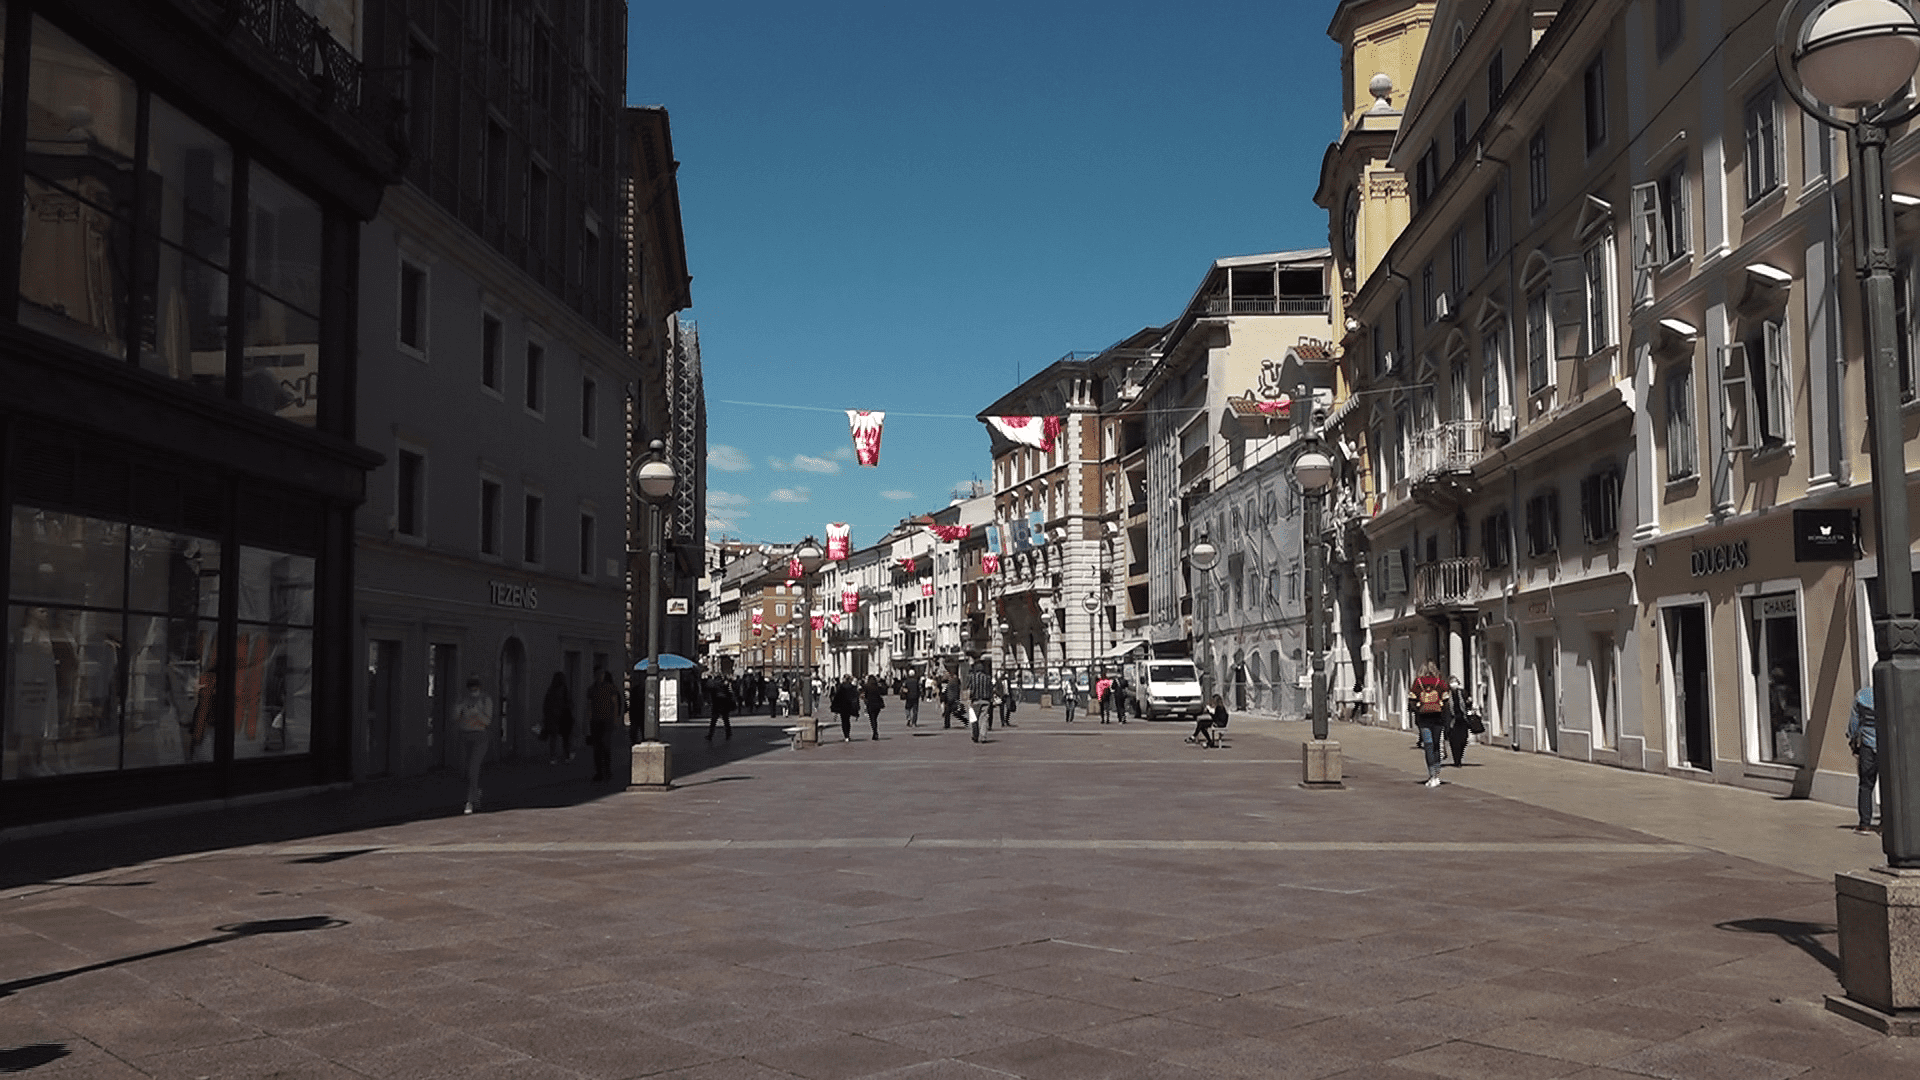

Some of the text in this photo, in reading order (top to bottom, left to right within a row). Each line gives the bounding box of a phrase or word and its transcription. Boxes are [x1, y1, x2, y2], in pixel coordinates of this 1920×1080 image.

[1690, 540, 1748, 577] DOUGLAS
[489, 580, 537, 609] TEZENIS
[1764, 599, 1796, 614] CHANEL
